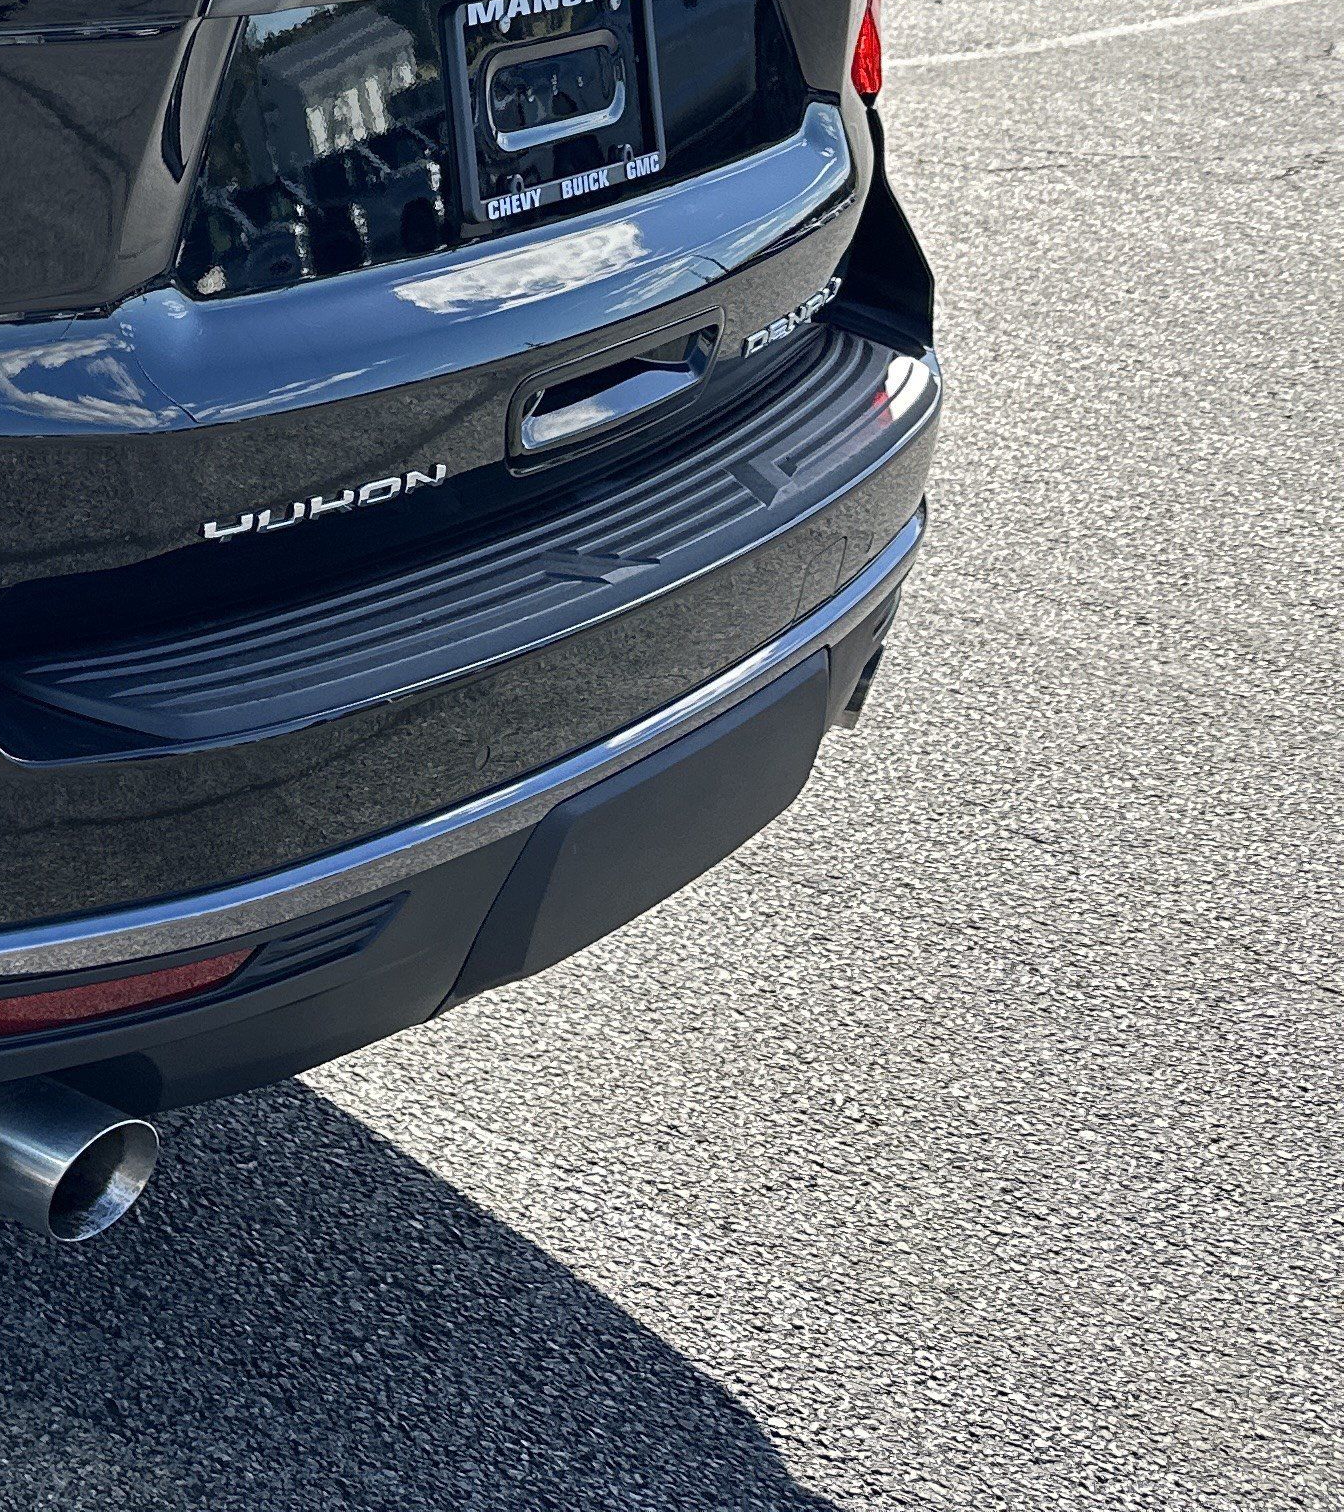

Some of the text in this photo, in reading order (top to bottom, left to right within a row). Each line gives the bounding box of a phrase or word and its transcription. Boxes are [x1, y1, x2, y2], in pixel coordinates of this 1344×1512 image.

[487, 154, 660, 220] CHEVY BUICK GMC
[198, 463, 446, 541] YUKON
